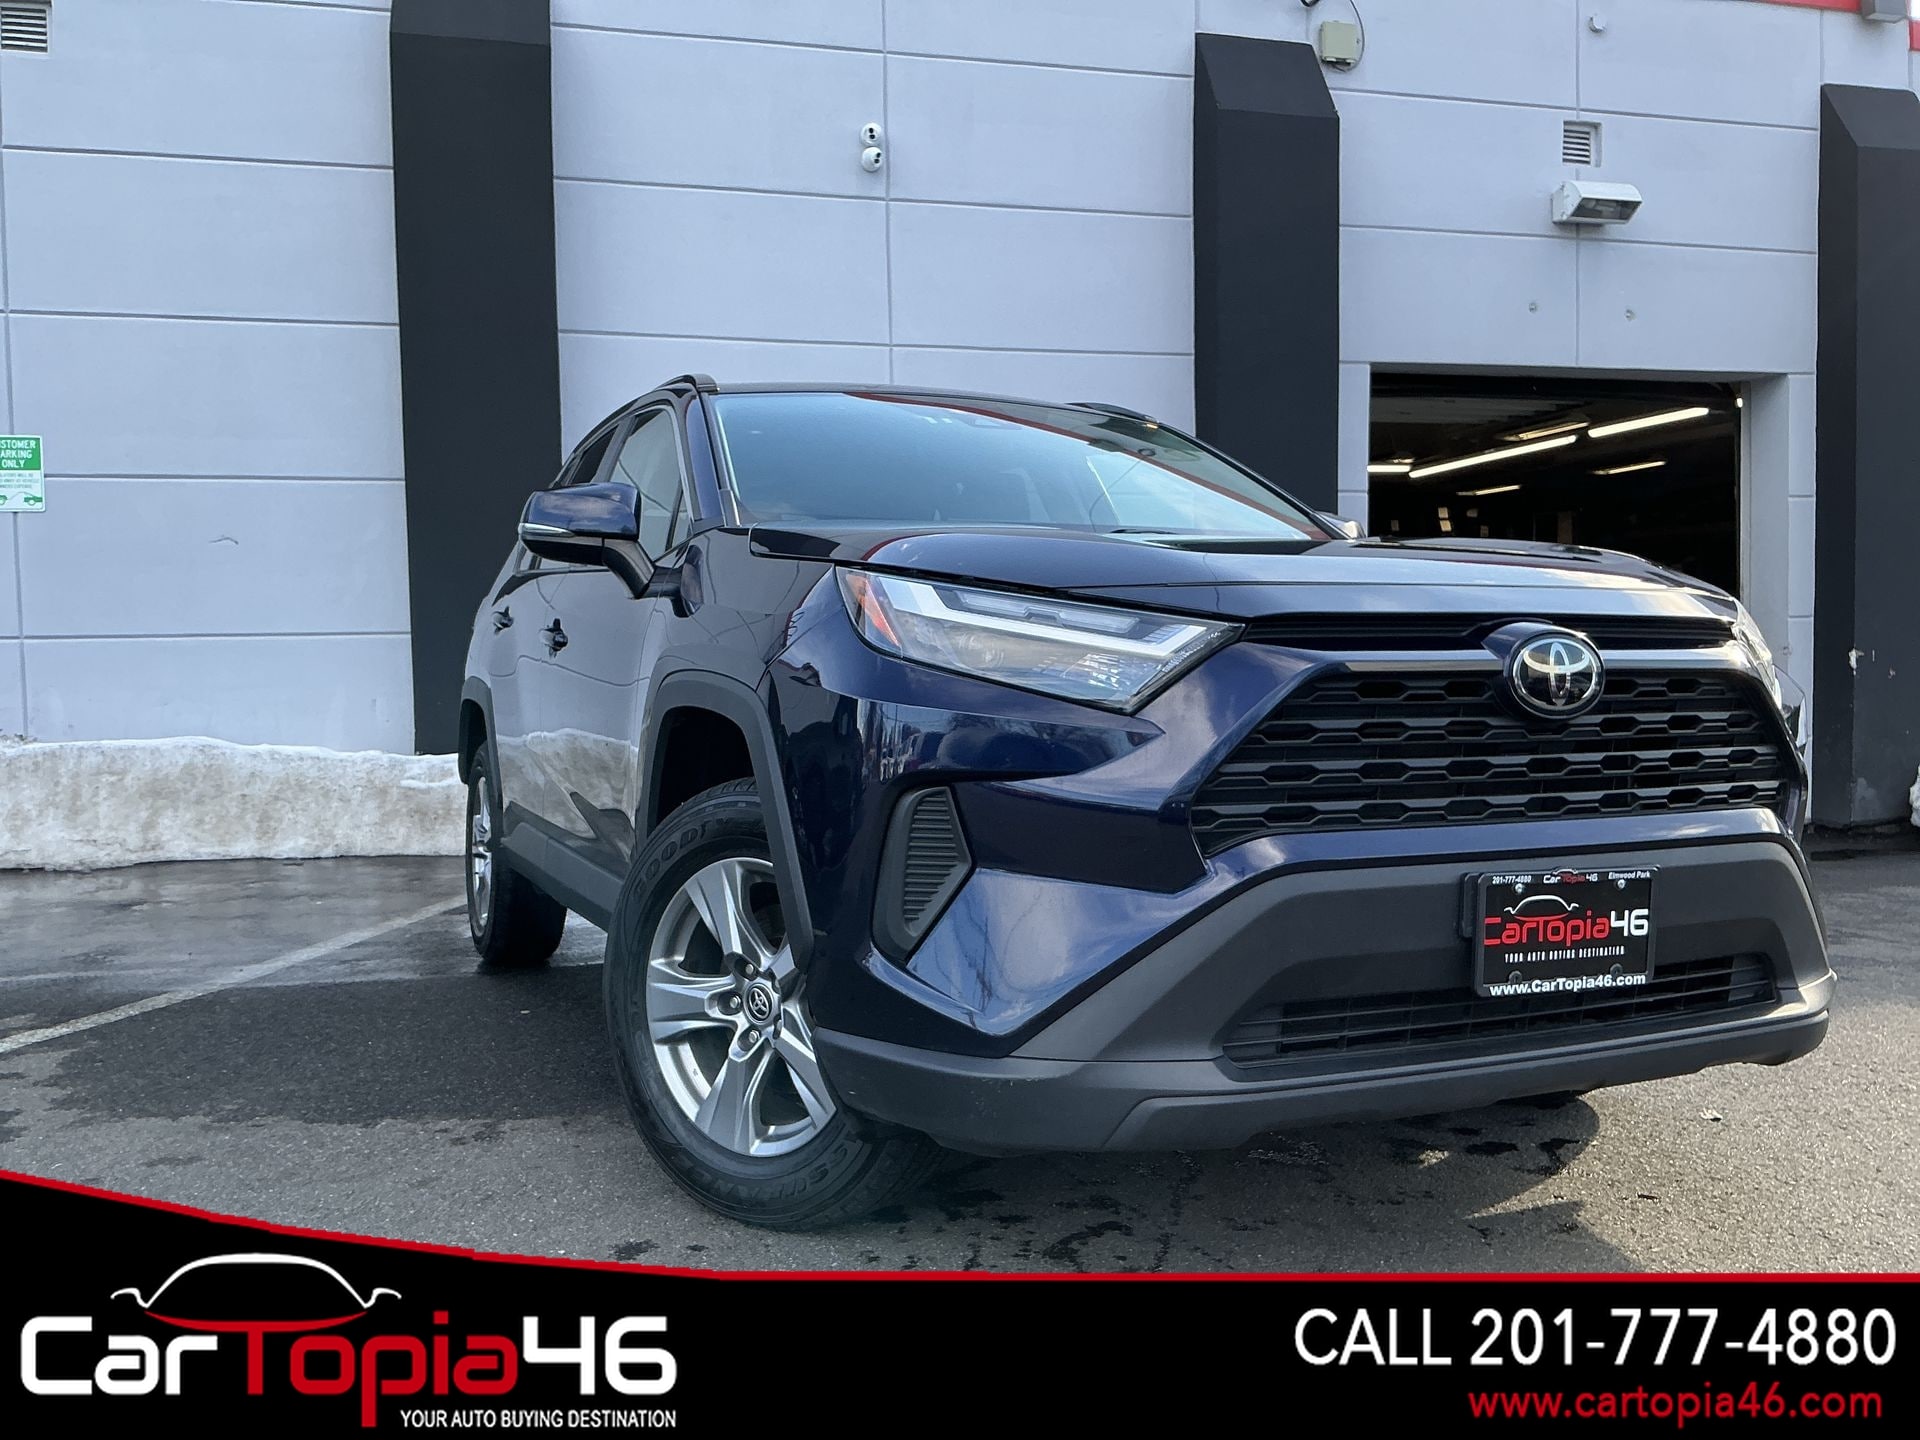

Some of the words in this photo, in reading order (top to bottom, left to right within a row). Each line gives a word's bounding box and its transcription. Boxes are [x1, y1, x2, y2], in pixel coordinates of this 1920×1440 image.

[0, 440, 36, 449] STOMER
[0, 449, 33, 459] ARKING
[1, 459, 25, 468] ONLY
[1608, 872, 1636, 880] Elmwood
[1636, 870, 1651, 879] Park
[1490, 974, 1646, 997] www.CarTopia46.com
